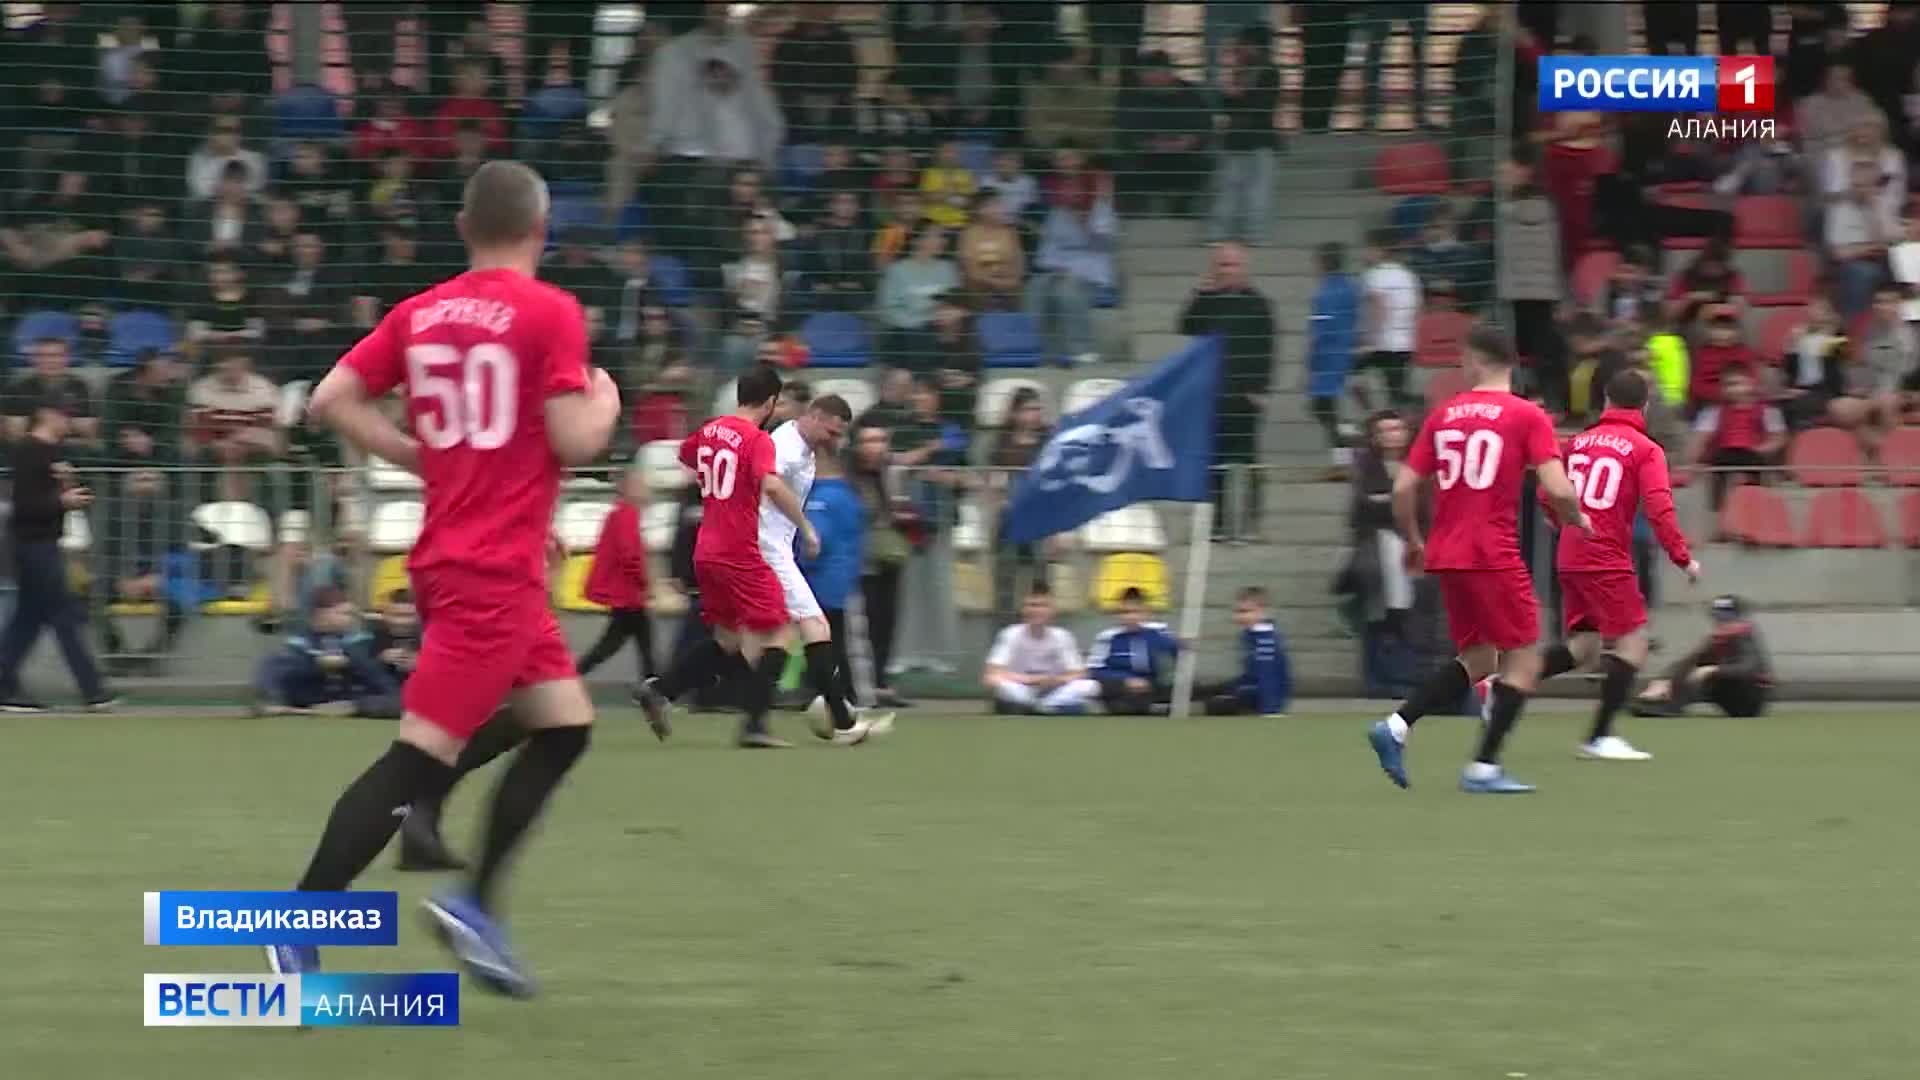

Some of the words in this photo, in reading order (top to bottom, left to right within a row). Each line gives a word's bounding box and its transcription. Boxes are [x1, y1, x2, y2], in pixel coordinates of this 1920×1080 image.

[405, 343, 520, 450] 50
[696, 445, 739, 500] 50
[1433, 428, 1504, 491] 50
[1567, 452, 1624, 510] 50
